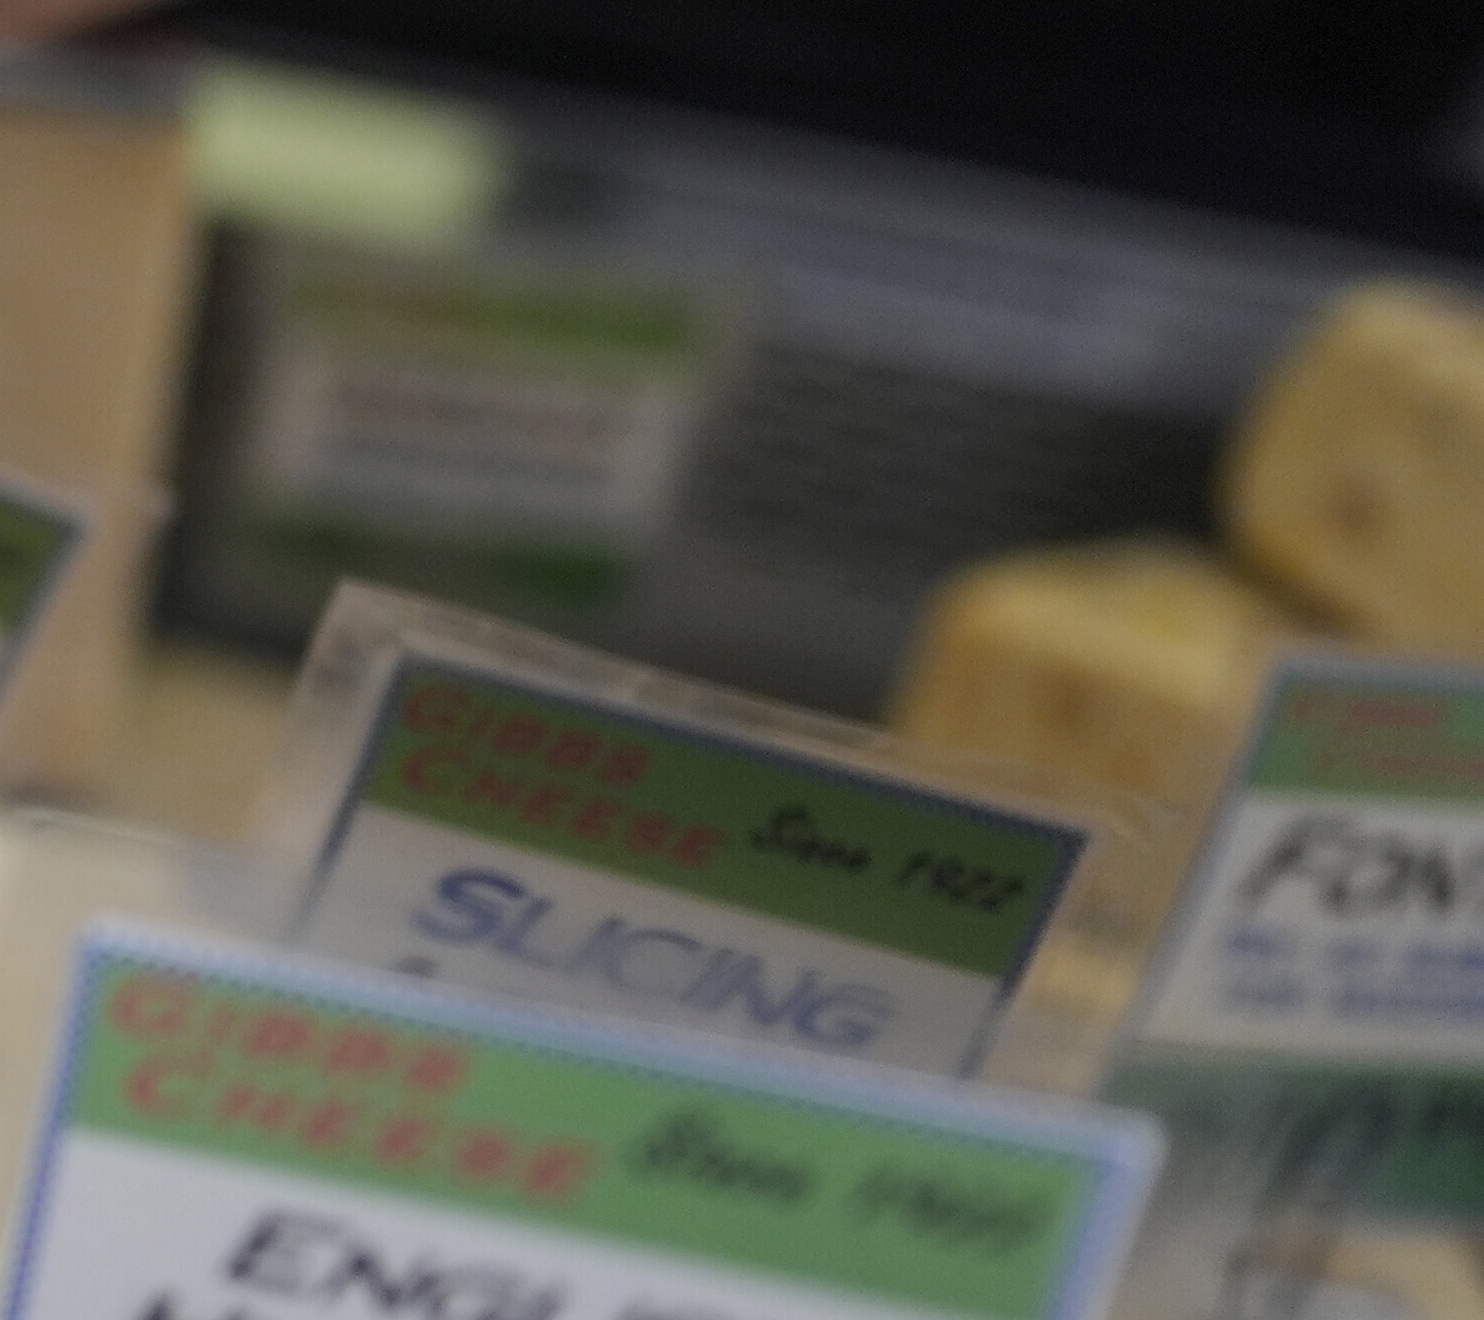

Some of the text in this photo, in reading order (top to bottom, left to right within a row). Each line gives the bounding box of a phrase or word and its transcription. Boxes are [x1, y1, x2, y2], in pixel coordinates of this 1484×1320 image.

[402, 681, 651, 780] GIBBS
[402, 745, 729, 871] CHEESE
[408, 867, 896, 1048] SLICING
[108, 968, 470, 1097] GIBBS
[124, 1051, 595, 1206] CHEESE
